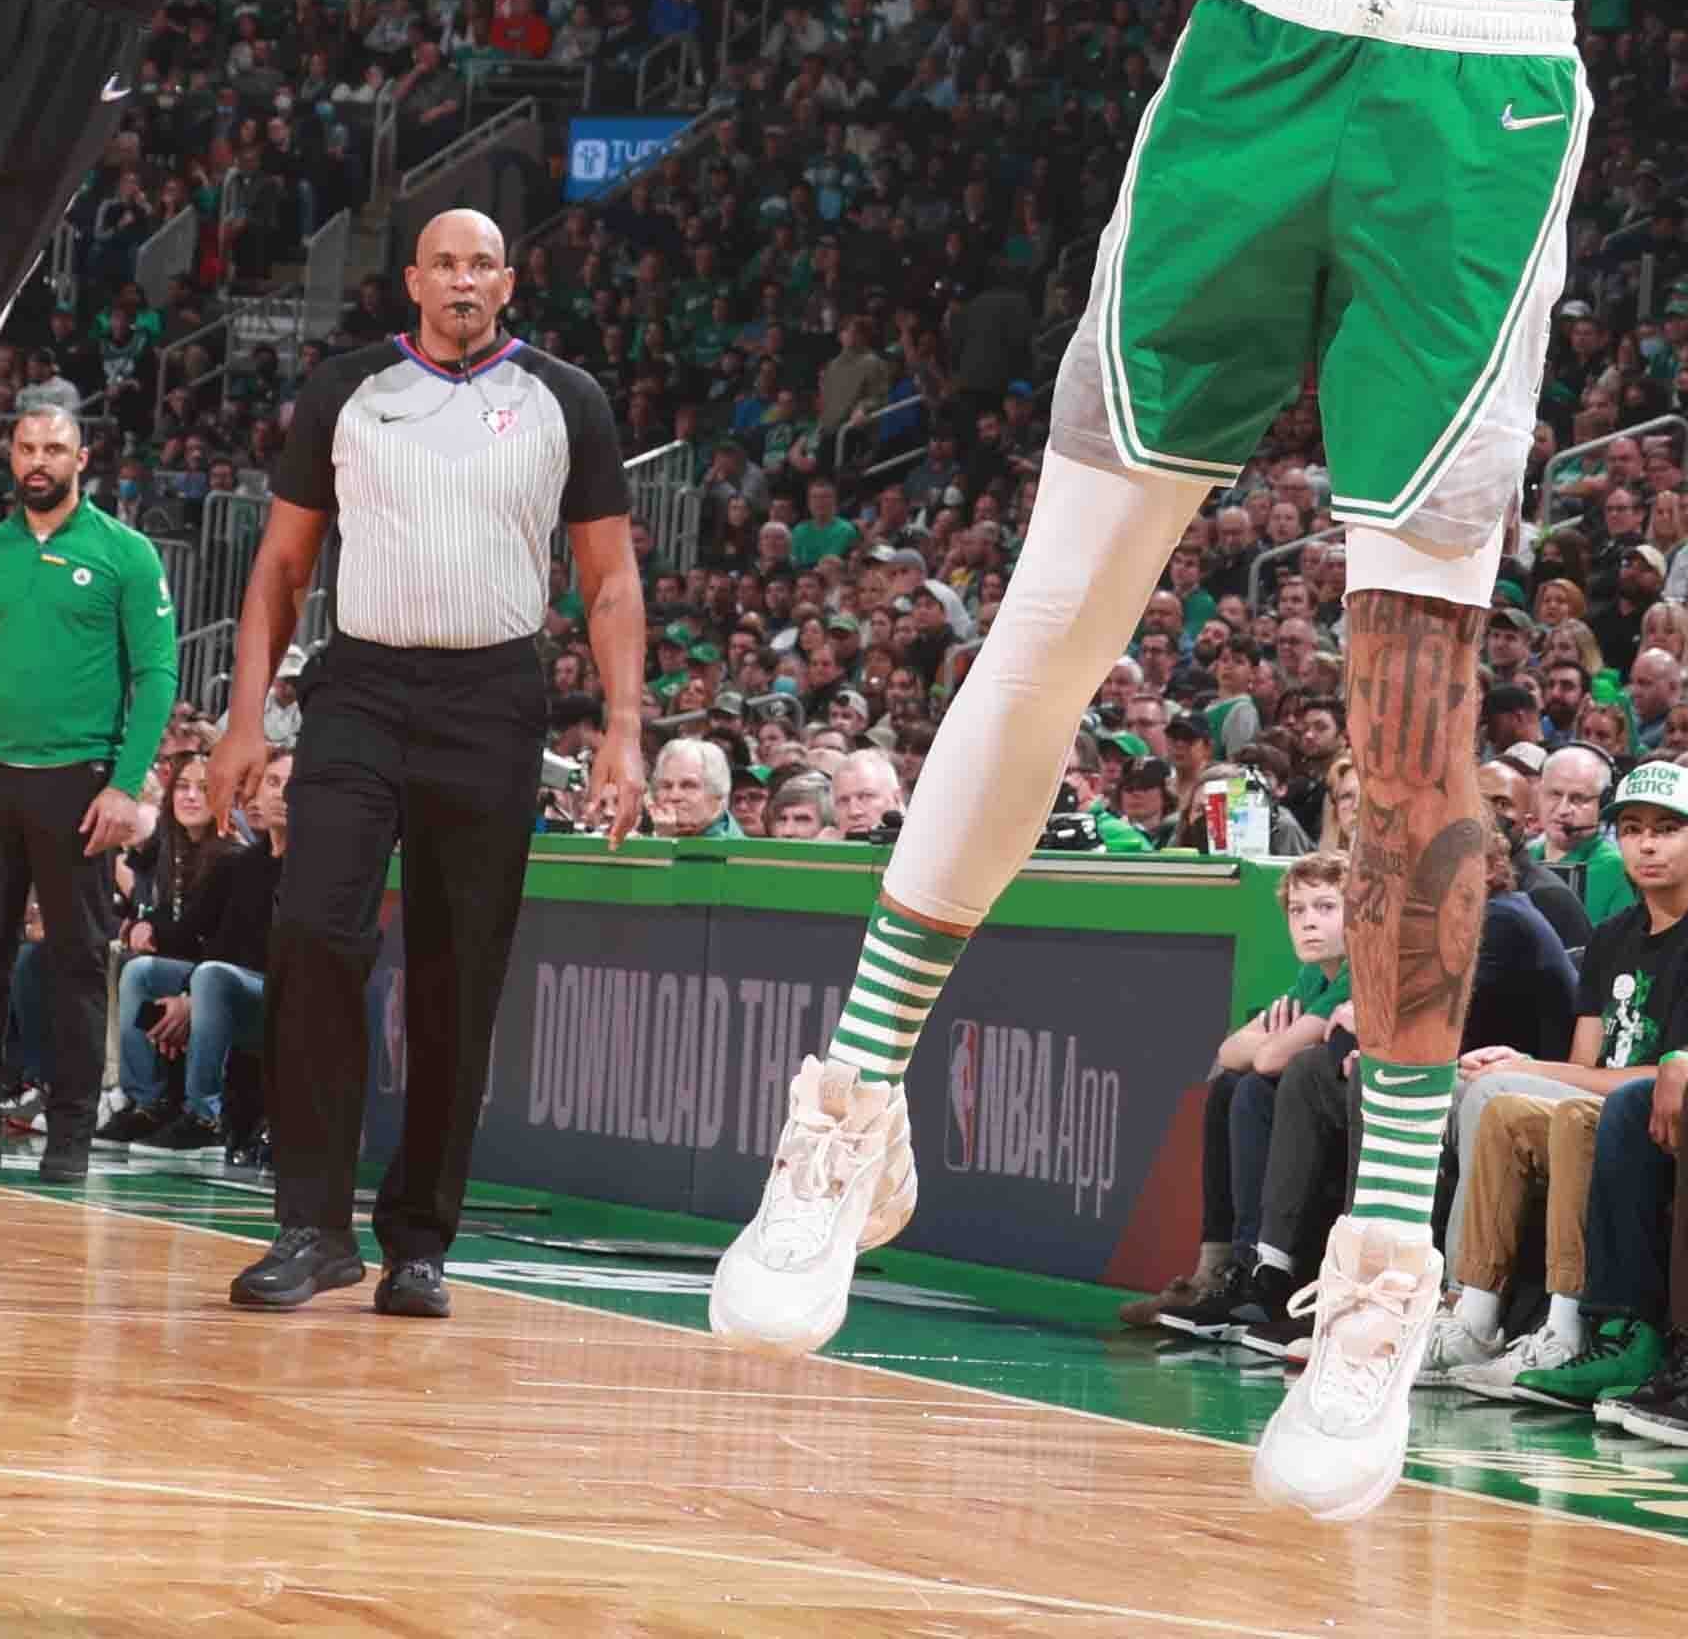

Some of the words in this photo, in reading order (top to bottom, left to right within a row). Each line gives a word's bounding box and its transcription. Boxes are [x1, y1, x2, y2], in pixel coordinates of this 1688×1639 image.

[528, 962, 730, 1150] DOWNLOAD
[977, 1022, 1053, 1182] NBA
[1054, 1036, 1121, 1218] App
